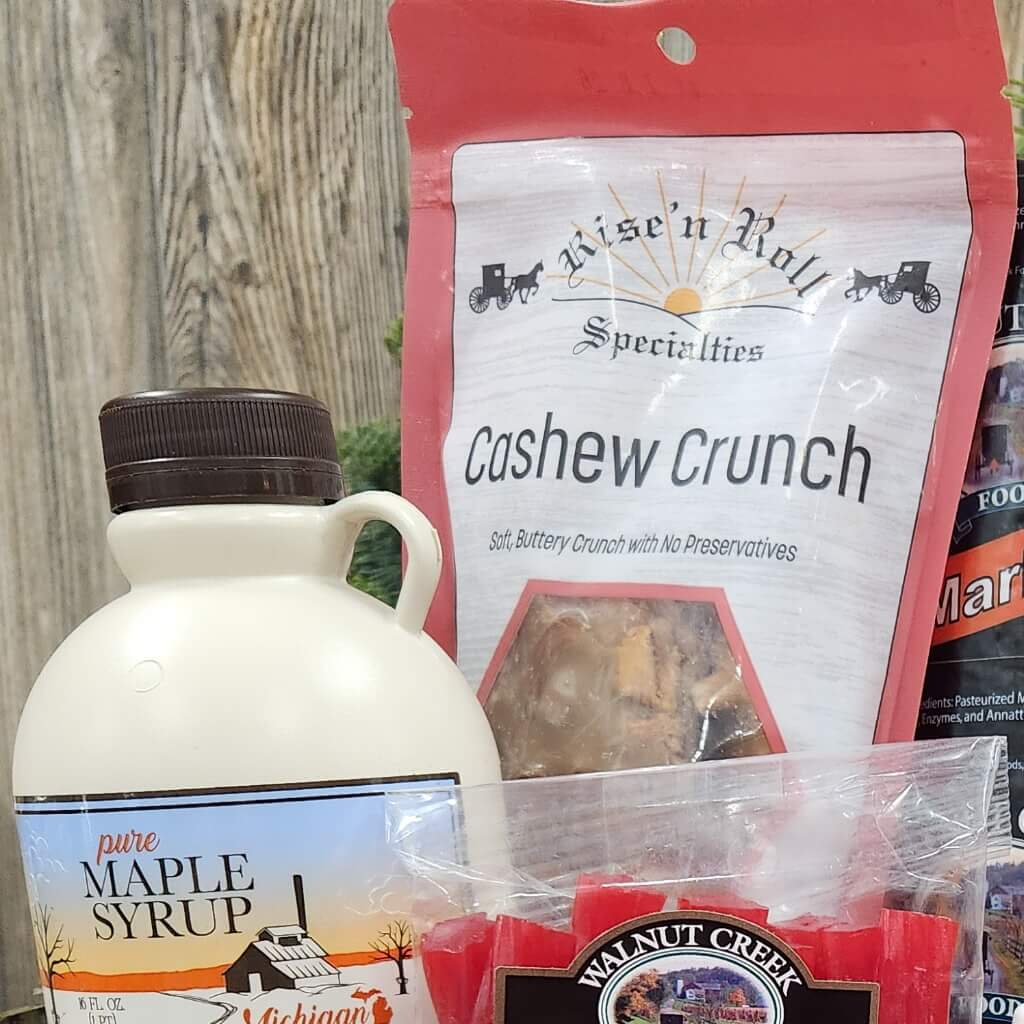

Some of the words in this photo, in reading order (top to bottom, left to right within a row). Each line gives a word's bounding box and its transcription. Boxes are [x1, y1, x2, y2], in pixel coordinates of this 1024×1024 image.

[721, 207, 830, 298] Roll
[573, 316, 764, 363] Specialties
[465, 411, 661, 488] Cashew
[672, 425, 872, 504] Crunch
[489, 528, 514, 553] Soft,
[516, 529, 571, 556] Buttery
[572, 534, 626, 555] Crunch
[628, 533, 659, 555] with
[663, 534, 682, 554] No
[684, 534, 798, 562] Preservatives
[922, 711, 963, 725] Enzymes,
[964, 710, 983, 722] and
[955, 692, 1015, 708] Pasteurized
[96, 829, 160, 864] pure
[80, 853, 255, 899] MAPLE
[92, 896, 252, 941] SYRUP
[578, 924, 703, 992] WALNUT
[709, 927, 803, 997] CREEK
